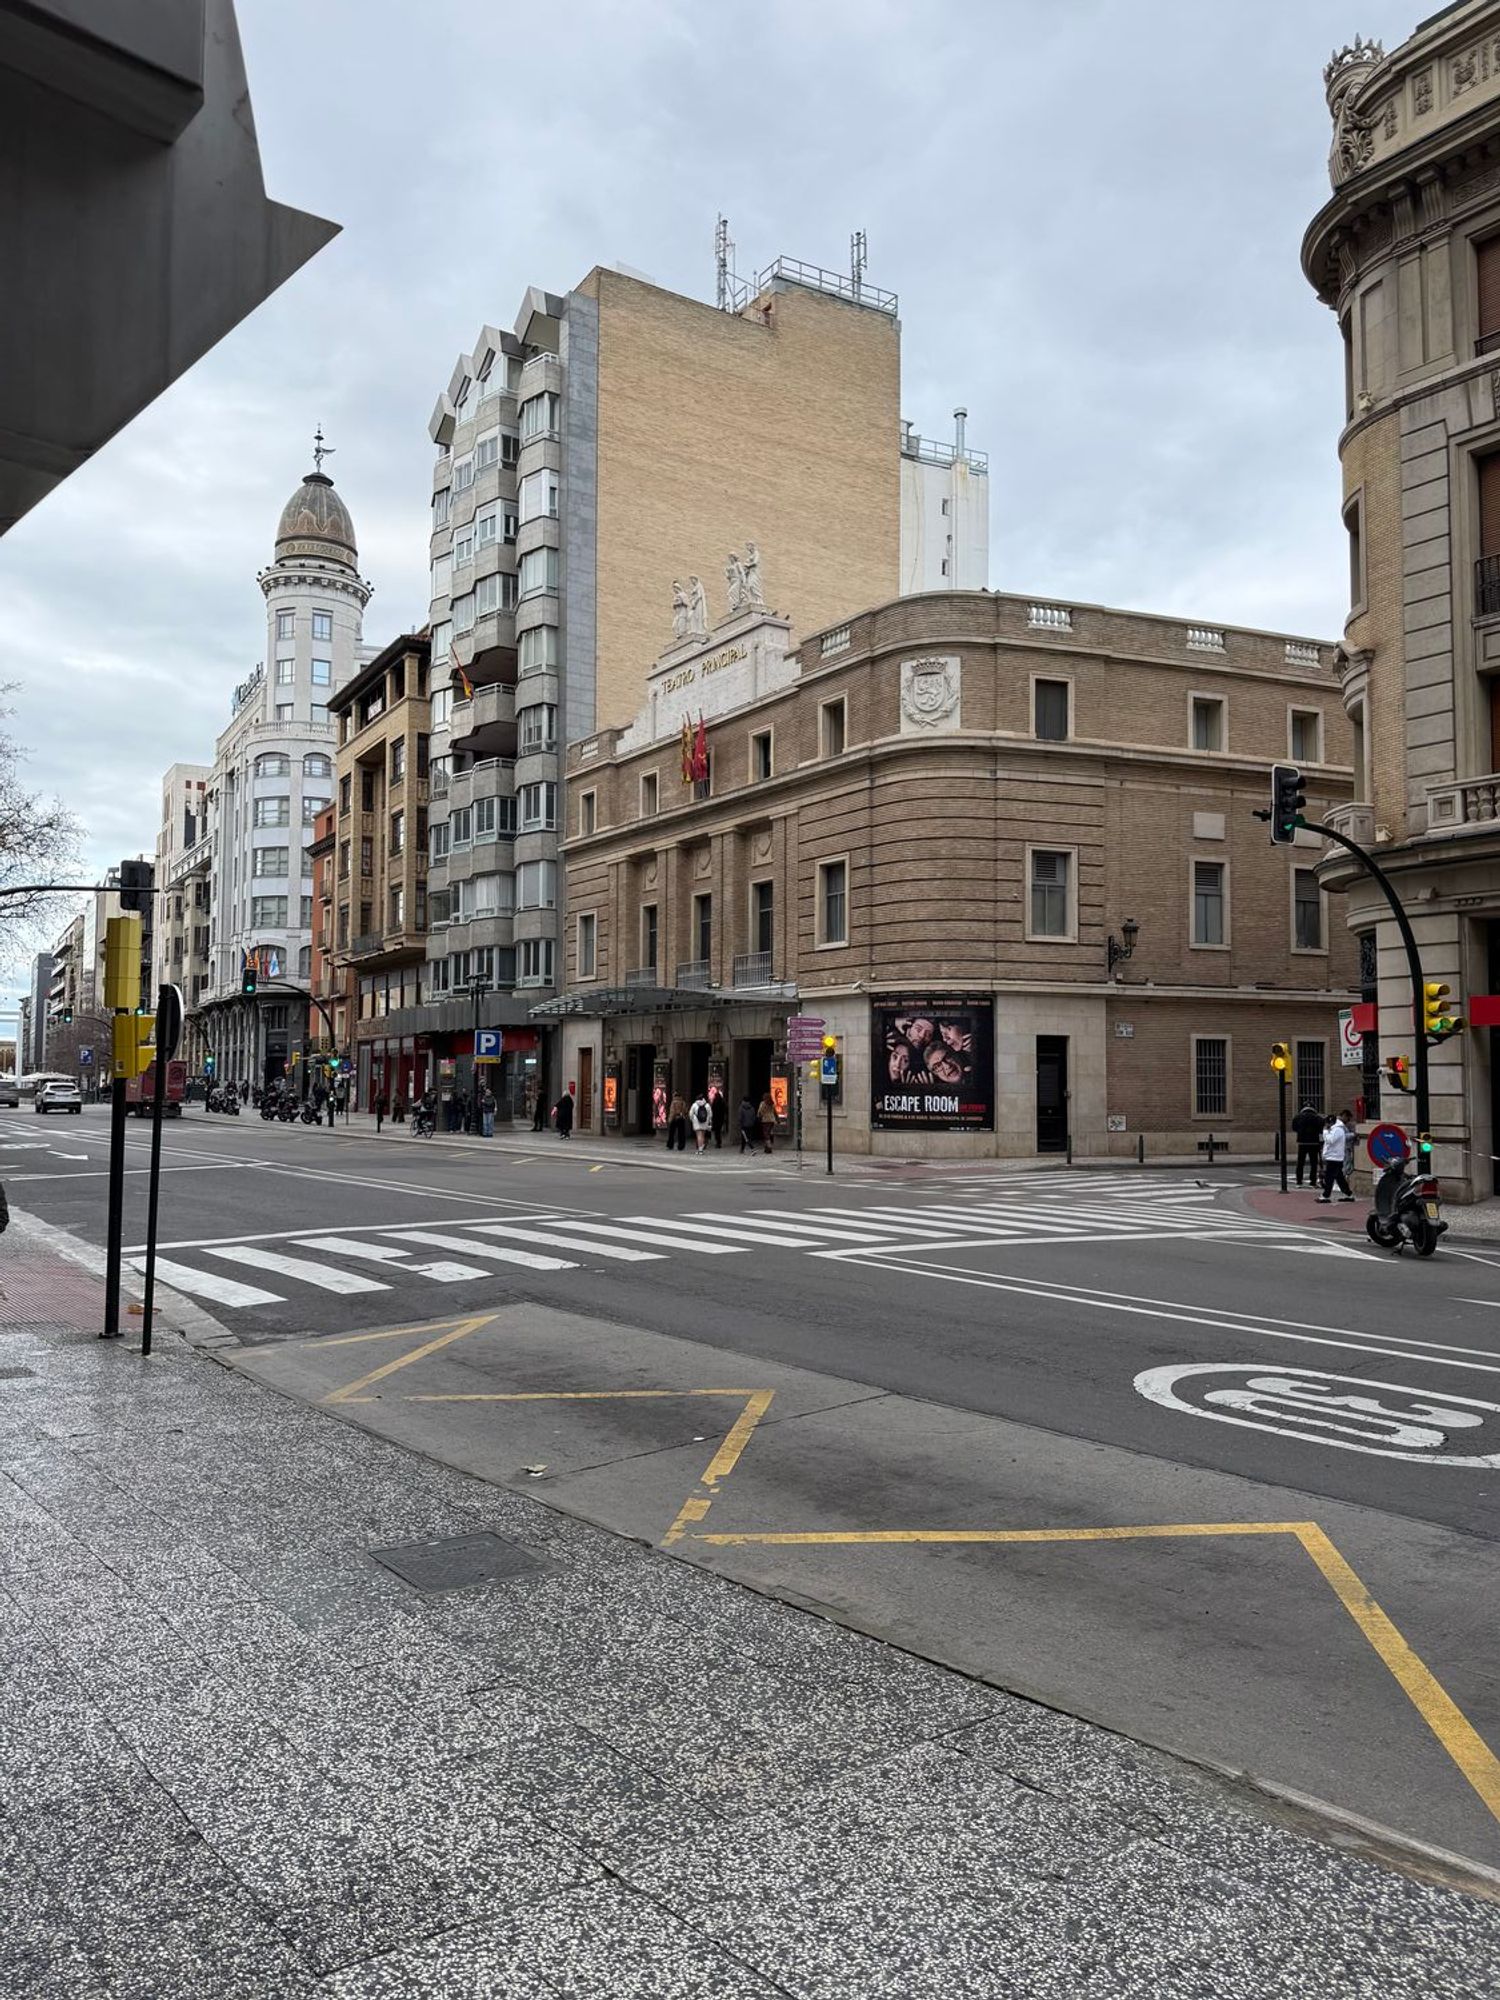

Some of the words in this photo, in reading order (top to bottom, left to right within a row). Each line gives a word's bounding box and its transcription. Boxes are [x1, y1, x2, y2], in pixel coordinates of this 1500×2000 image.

[661, 669, 695, 695] TEATRO
[701, 644, 747, 678] PRINCIPAL
[480, 1033, 496, 1053] P
[884, 1094, 921, 1112] ESCAPE
[924, 1094, 960, 1113] ROOM
